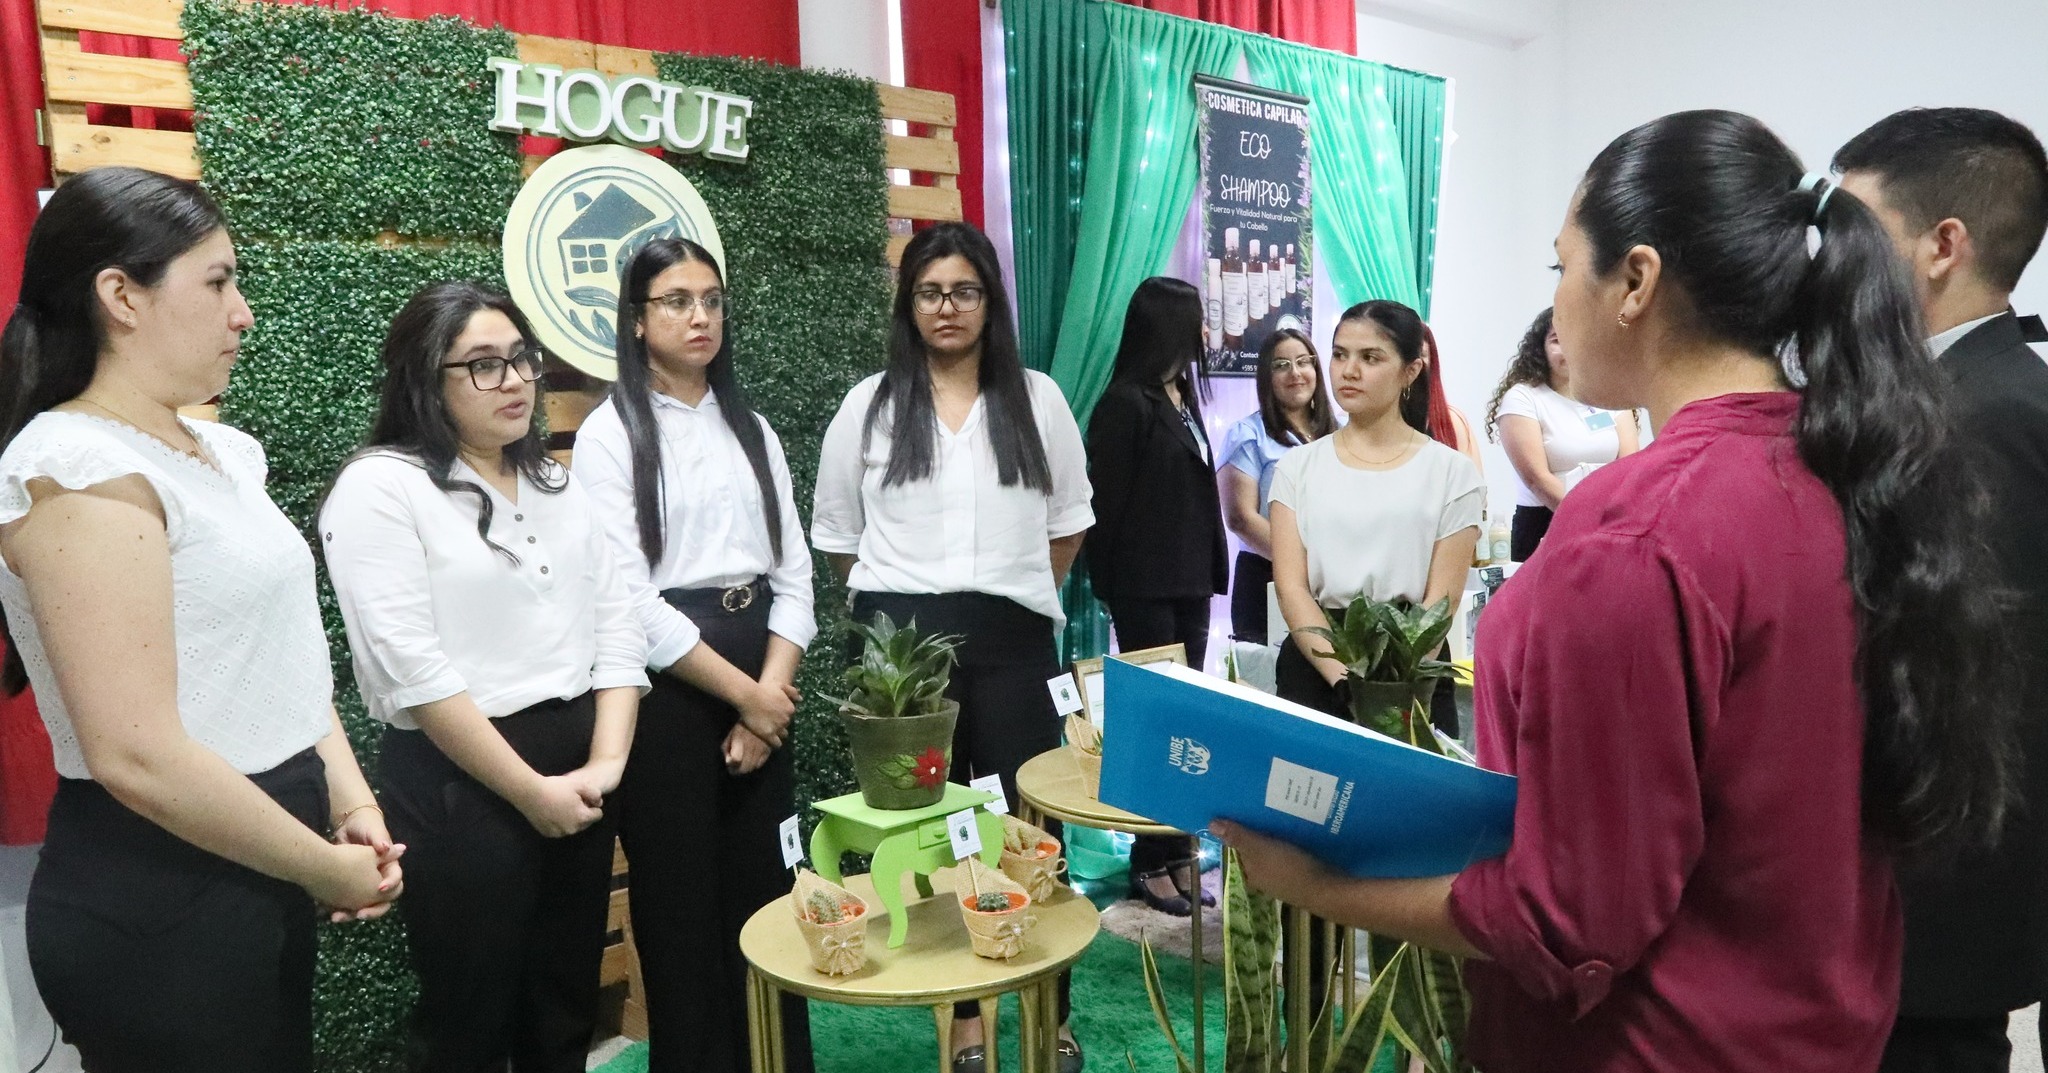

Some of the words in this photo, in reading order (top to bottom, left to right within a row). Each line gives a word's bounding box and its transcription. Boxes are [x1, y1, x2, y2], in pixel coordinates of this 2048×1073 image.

[490, 60, 753, 159] HOGUE
[1208, 92, 1262, 118] COSMETICA
[1264, 103, 1304, 127] CAPILAR
[1240, 130, 1272, 159] ECO
[1220, 174, 1291, 208] SHAMPOO
[1209, 203, 1231, 214] Fuerza
[1236, 207, 1260, 218] Vitalidad
[1261, 211, 1283, 221] Natural
[1283, 214, 1298, 223] para
[1240, 221, 1246, 229] tu
[1246, 221, 1269, 232] Cabello
[1168, 735, 1185, 767] UNIBE
[1330, 781, 1355, 835] IBEROAMERICANA
